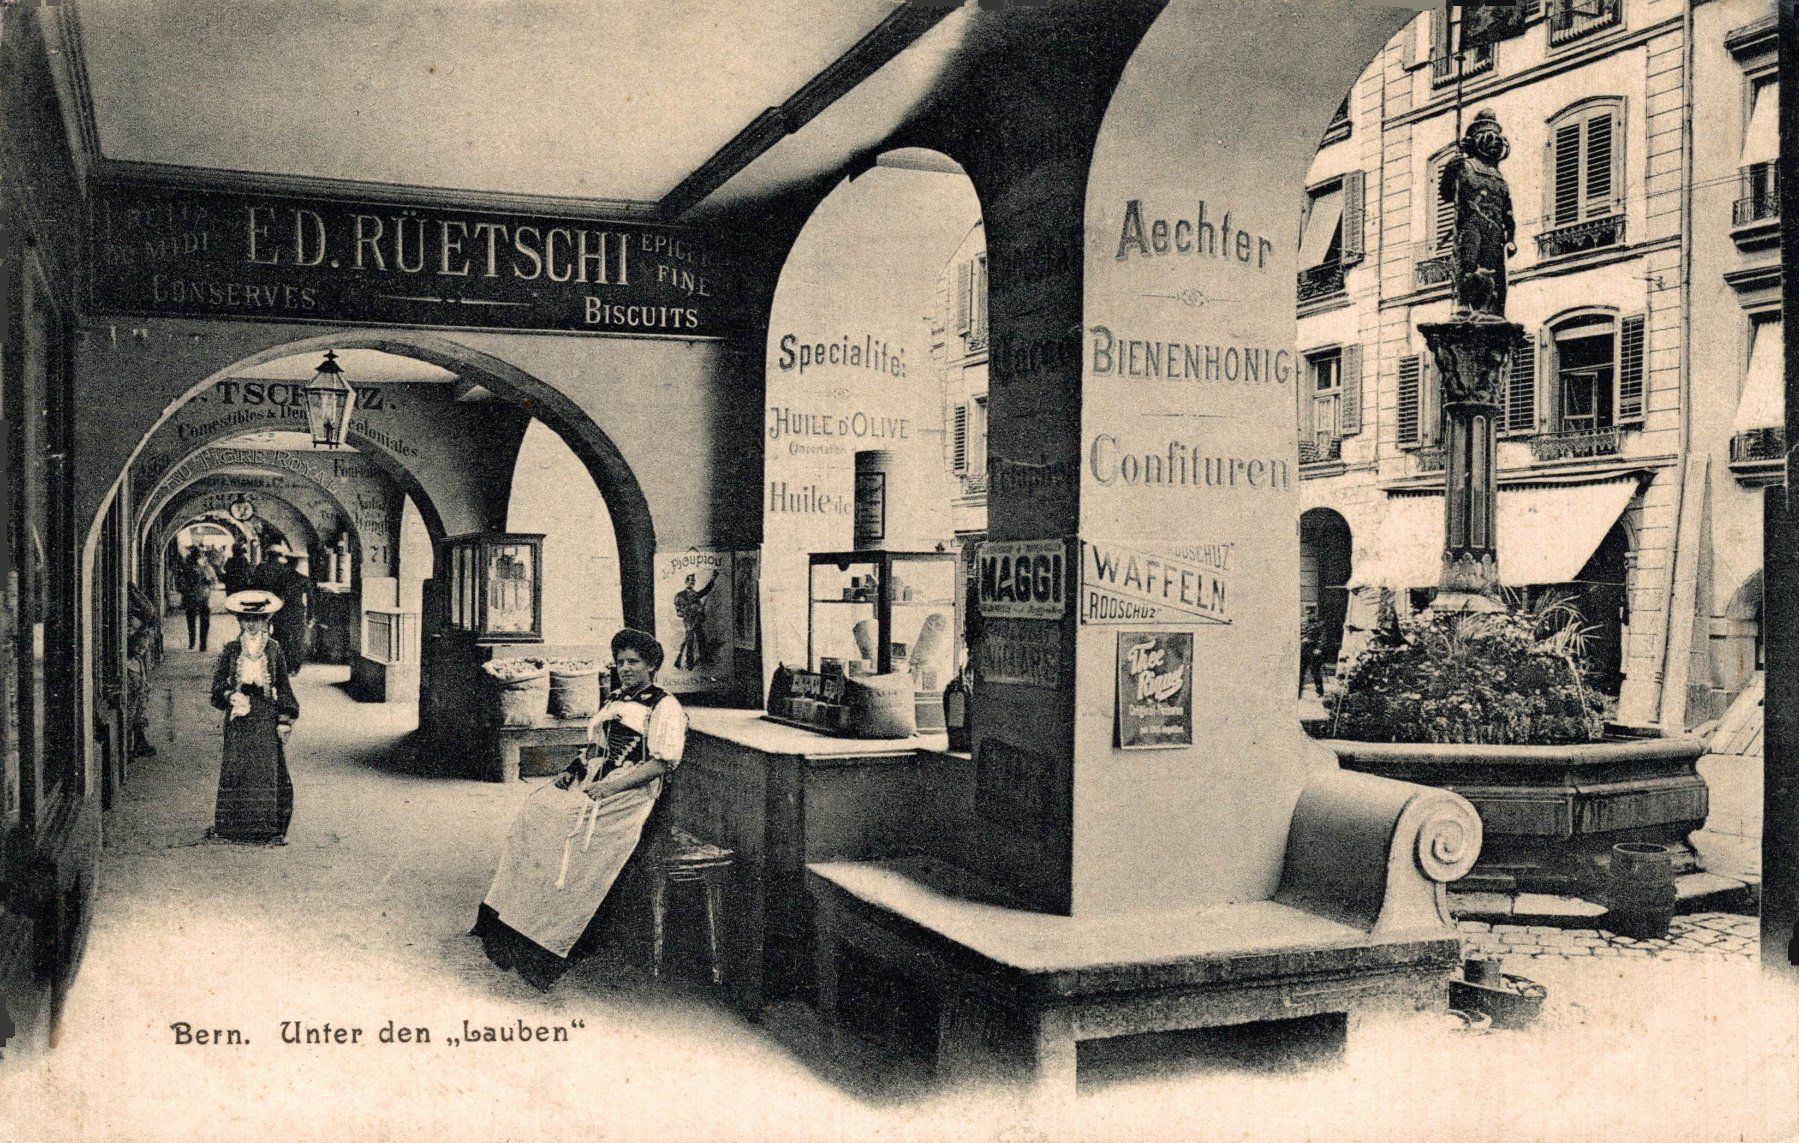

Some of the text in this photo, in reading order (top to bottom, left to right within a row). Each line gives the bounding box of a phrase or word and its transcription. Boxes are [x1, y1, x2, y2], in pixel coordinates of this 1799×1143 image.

[247, 205, 630, 287] ED. RÜETSCHI
[1115, 199, 1273, 270] Aechter
[152, 273, 317, 310] CONSERVES
[583, 295, 699, 328] BISCUITS
[1089, 324, 1291, 385] BIENENHONIG
[177, 408, 264, 440] Comestibles
[769, 406, 833, 439] HUILE
[1089, 433, 1290, 489] Confituren
[770, 481, 830, 514] Huile
[980, 554, 1063, 603] MAGGI
[1092, 544, 1225, 615] WAFFELN
